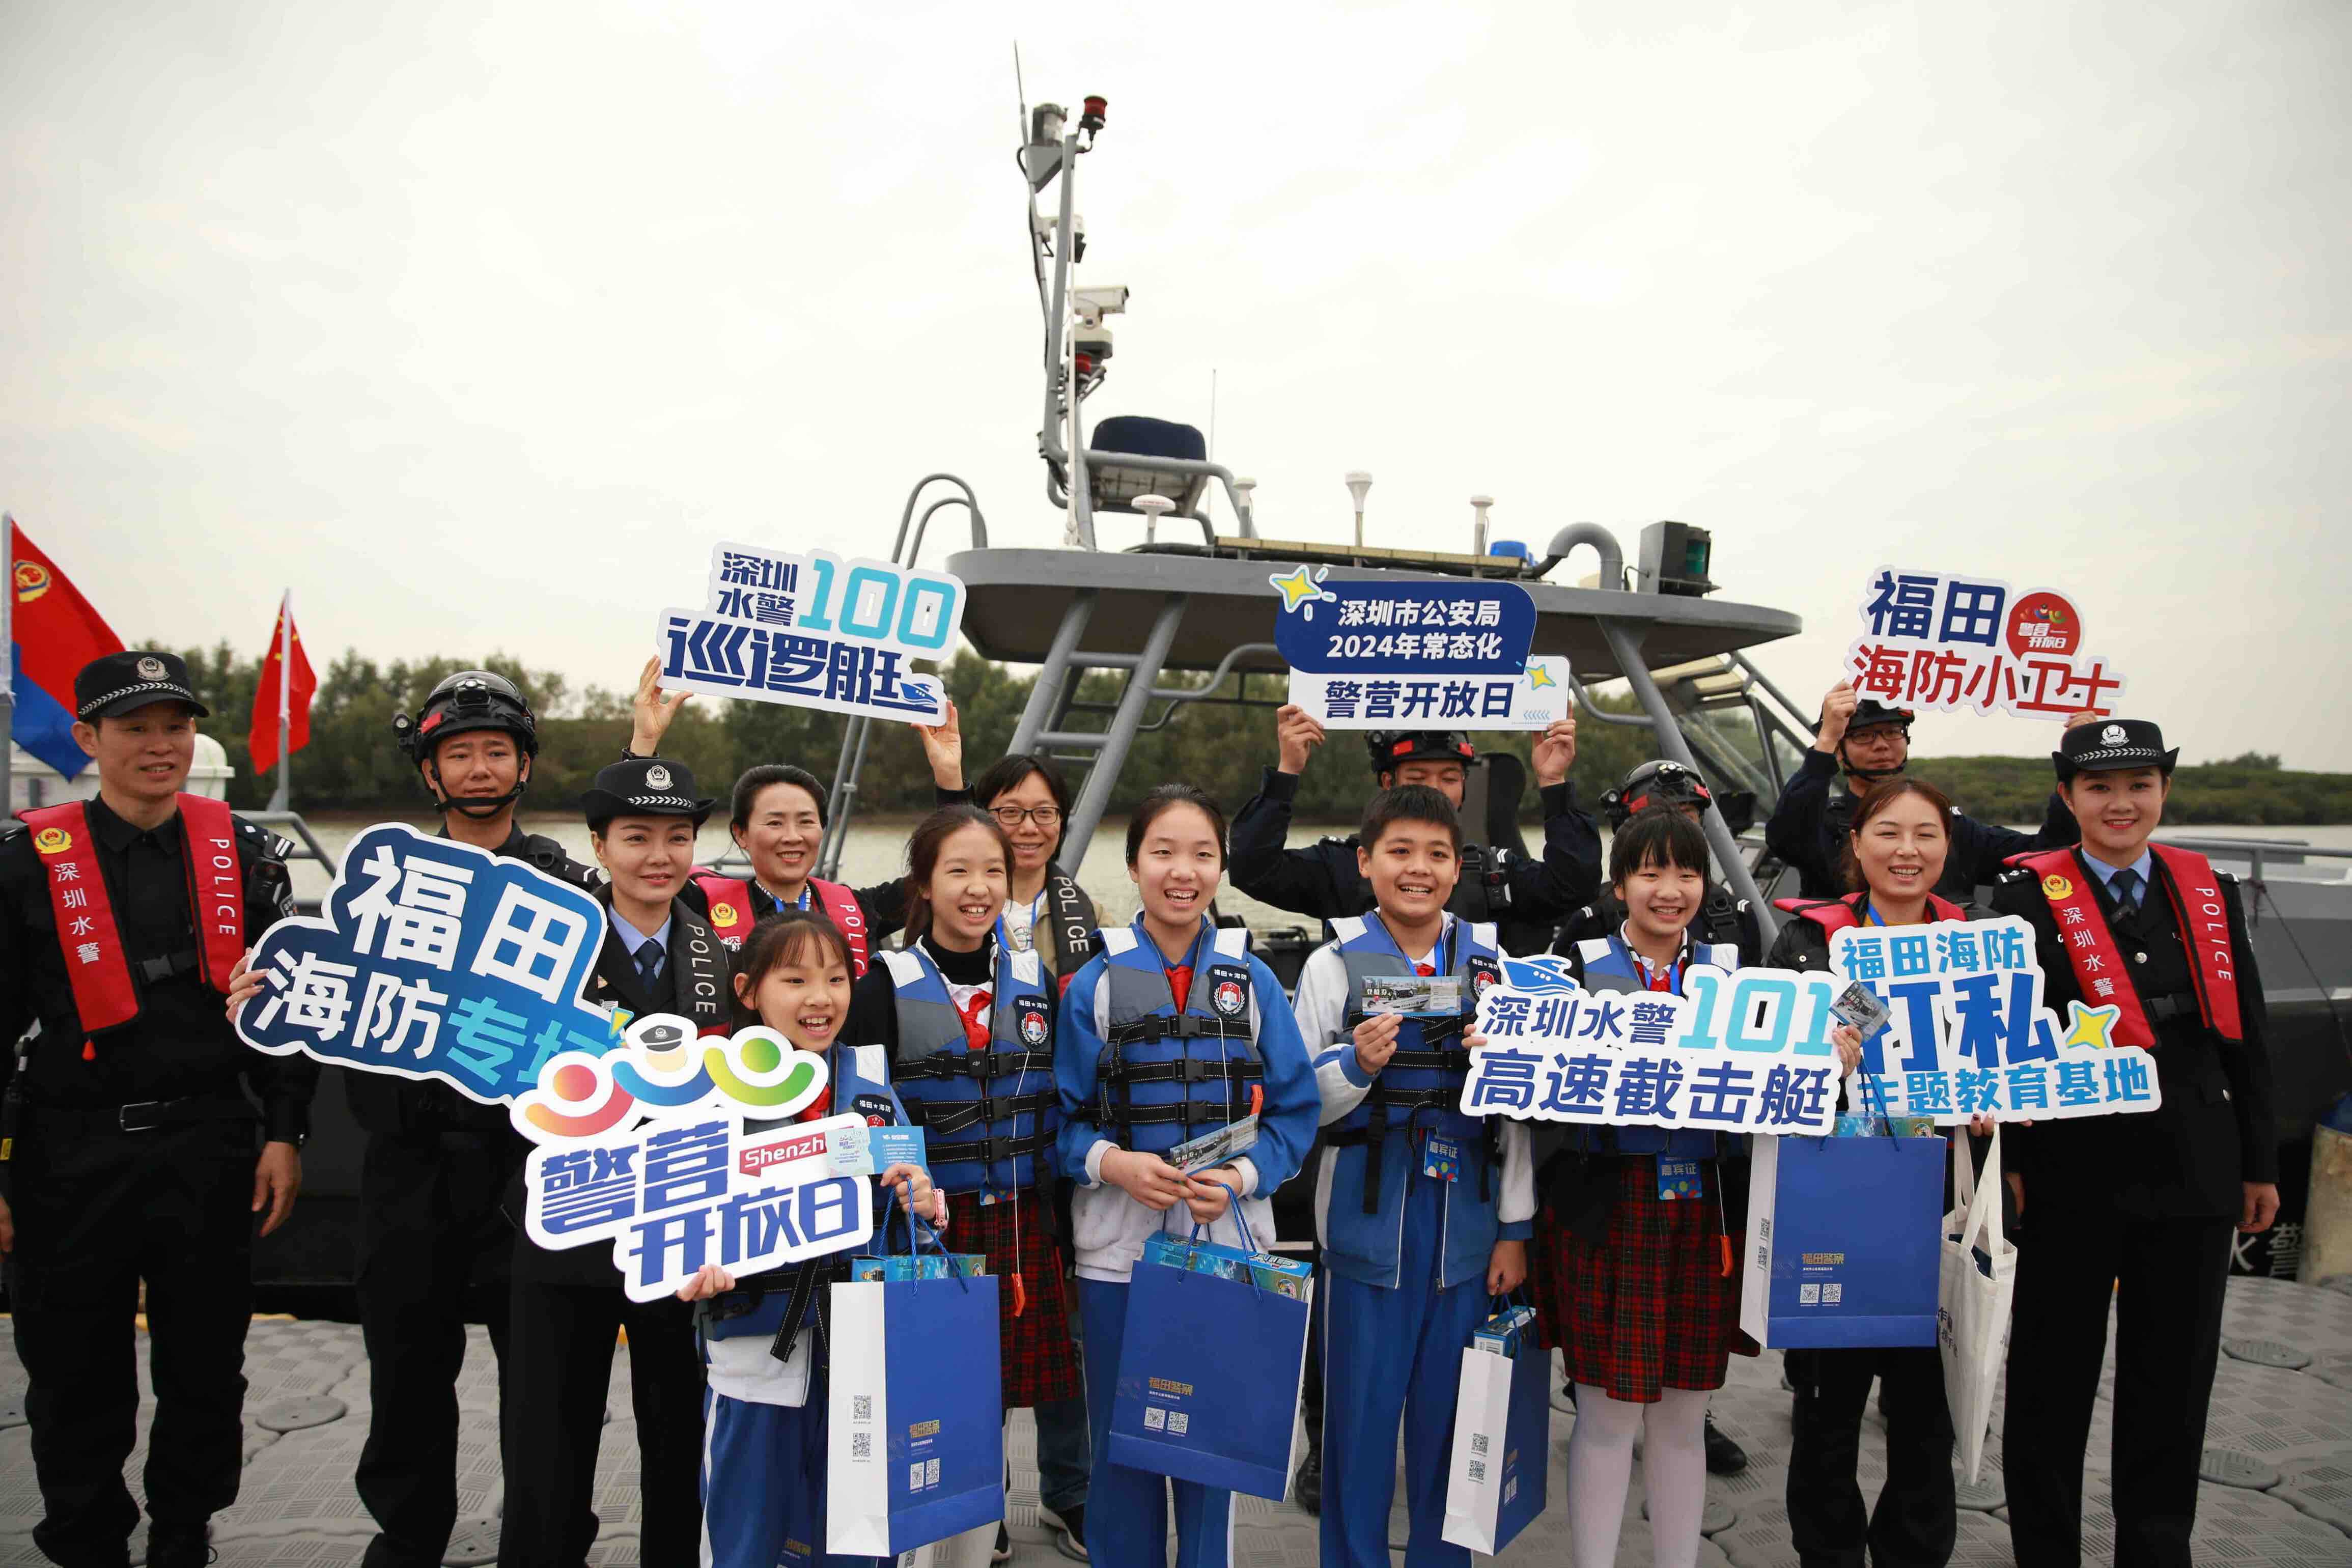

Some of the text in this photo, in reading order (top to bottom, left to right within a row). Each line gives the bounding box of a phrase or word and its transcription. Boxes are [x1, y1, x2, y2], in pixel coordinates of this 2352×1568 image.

[716, 588, 795, 627] 水警
[720, 551, 798, 593] 深圳
[798, 558, 956, 649] 100
[1867, 571, 2006, 647] 福田
[1326, 633, 1503, 659] 2024年常态化
[1338, 599, 1501, 627] 深圳市公安局
[663, 617, 938, 714] 巡逻艇
[1325, 680, 1514, 718] 警营开放日
[1852, 644, 2120, 716] 海防小卫士
[54, 862, 101, 964] 深圳水警
[209, 838, 236, 936] POLICE
[347, 845, 587, 1004] 福田
[1053, 876, 1090, 954] POLICE
[687, 922, 717, 1014] POLICE
[839, 904, 865, 979] POLIC
[1841, 926, 2026, 981] 福田海防
[2062, 907, 2115, 997] 深圳水警
[2195, 887, 2232, 982] POLICE
[1481, 975, 1833, 1057] 深圳水警 101
[1470, 1047, 1831, 1127] 高速截击艇
[1857, 1056, 2151, 1115] 主题教育基地
[540, 1120, 730, 1235] 警营
[745, 1136, 824, 1168] Shenzh
[629, 1176, 859, 1286] 开放日
